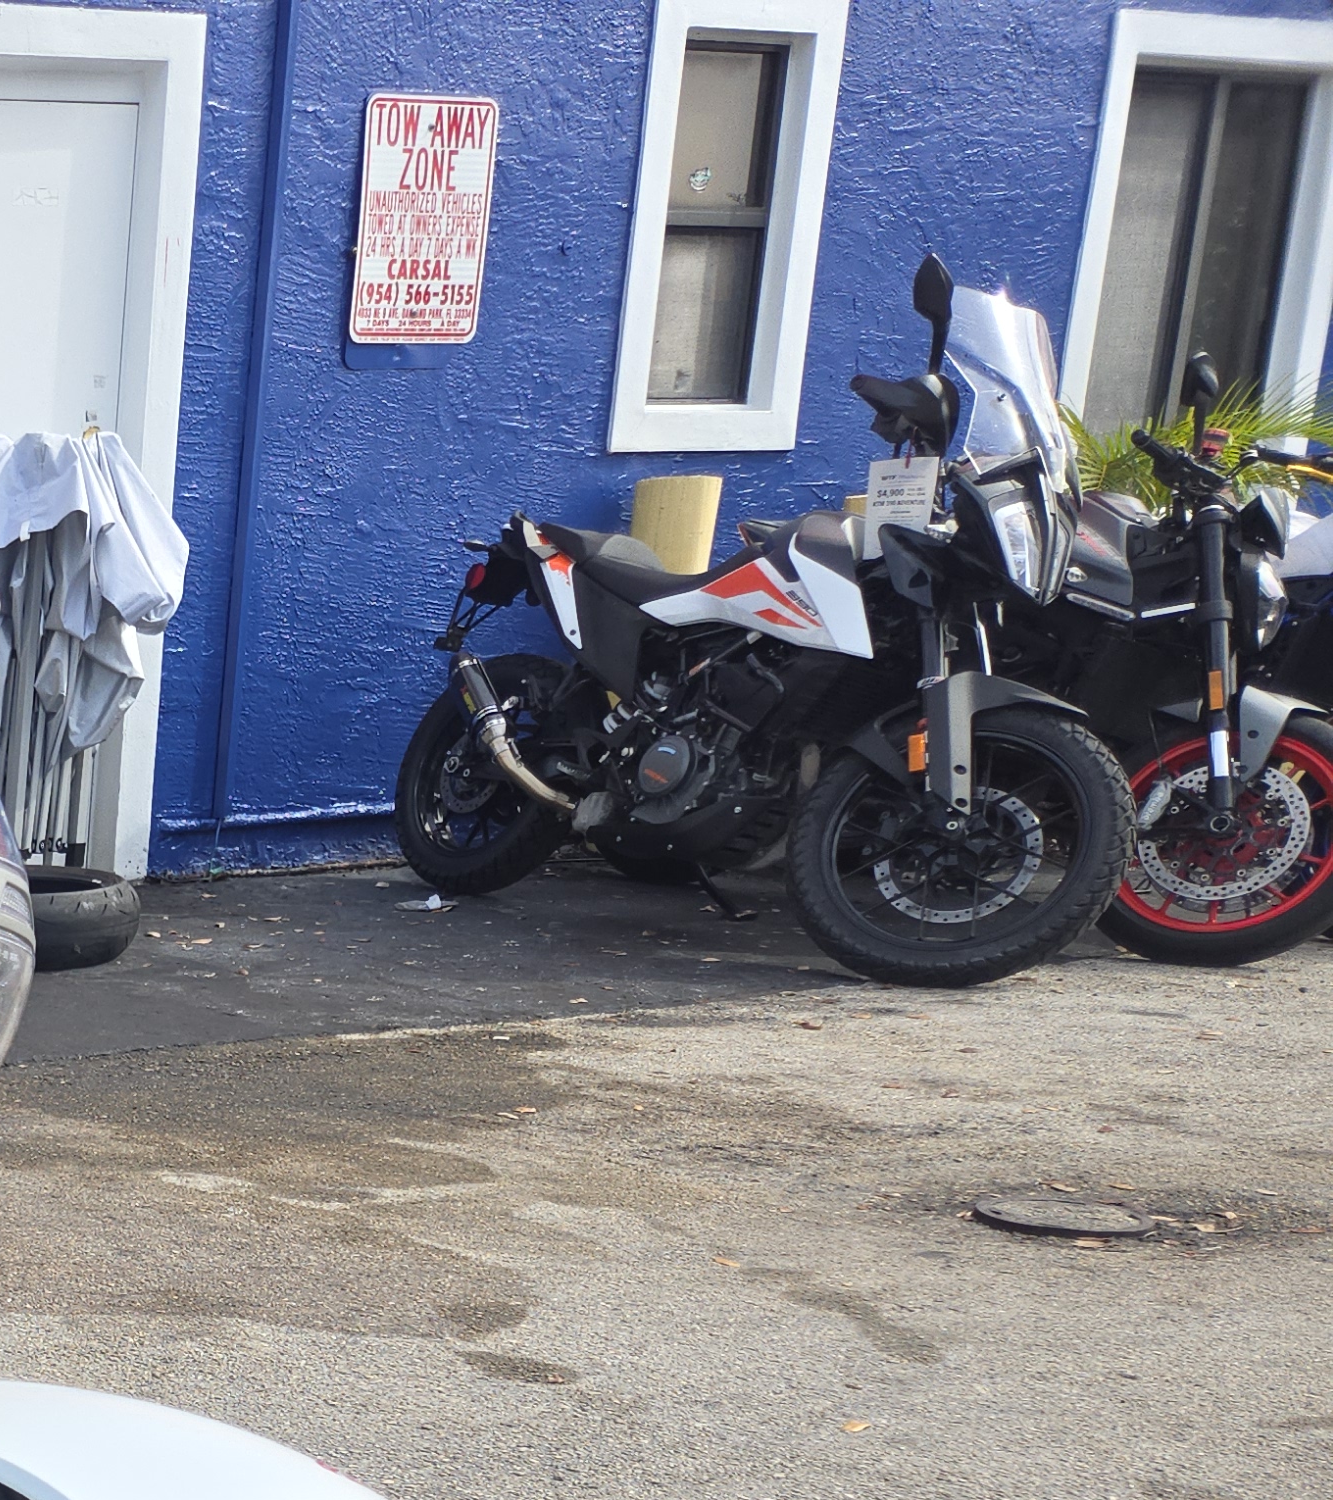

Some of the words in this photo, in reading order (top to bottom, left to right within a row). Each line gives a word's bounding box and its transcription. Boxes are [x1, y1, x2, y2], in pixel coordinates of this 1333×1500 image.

[376, 102, 421, 147] TOW
[430, 105, 491, 150] AWAY
[399, 147, 459, 192] ZONE
[369, 190, 437, 213] UNAUTHORIZED
[442, 193, 482, 215] VEHICLES
[368, 213, 394, 235] TOWED
[397, 214, 406, 235] AT
[410, 214, 442, 236] OWNERS
[445, 215, 481, 237] EXPENSE
[366, 236, 377, 257] 24
[380, 236, 396, 258] HRS
[399, 237, 405, 258] A
[409, 237, 424, 258] DAY
[426, 237, 432, 258] 7
[434, 237, 453, 259] DAYS
[456, 238, 461, 259] A
[465, 238, 477, 259] WK
[387, 258, 451, 280] CARSAL
[360, 281, 399, 307] (954)
[404, 283, 474, 306] 566-5155
[374, 307, 381, 319] NE
[446, 309, 452, 320] FL
[877, 488, 905, 498] $4,900
